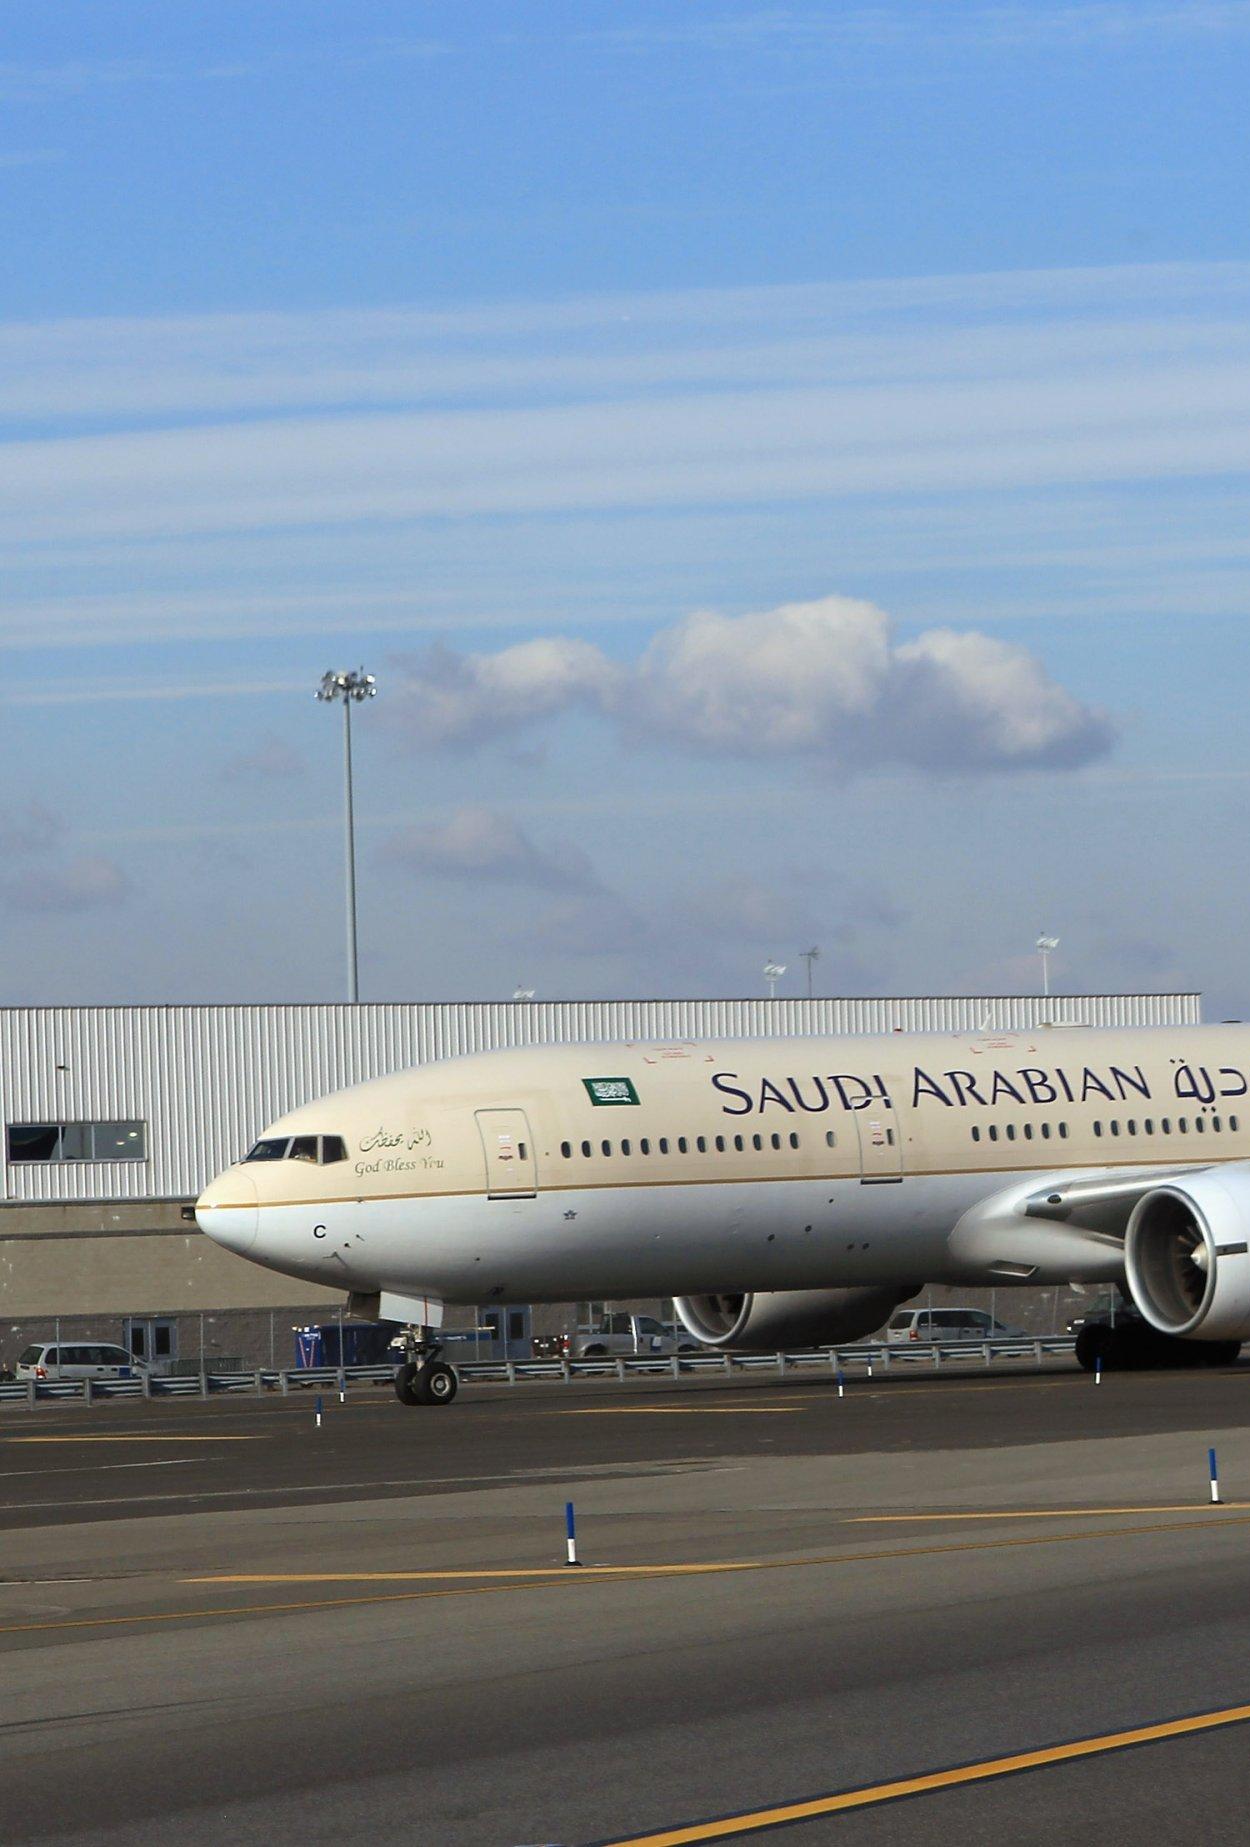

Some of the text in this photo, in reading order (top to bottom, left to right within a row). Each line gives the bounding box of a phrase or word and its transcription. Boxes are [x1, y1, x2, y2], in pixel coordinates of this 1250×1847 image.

[711, 1066, 1152, 1115] SAUDI ARABIAN
[354, 1158, 382, 1177] God
[384, 1157, 416, 1171] Bless
[313, 1224, 327, 1239] C
